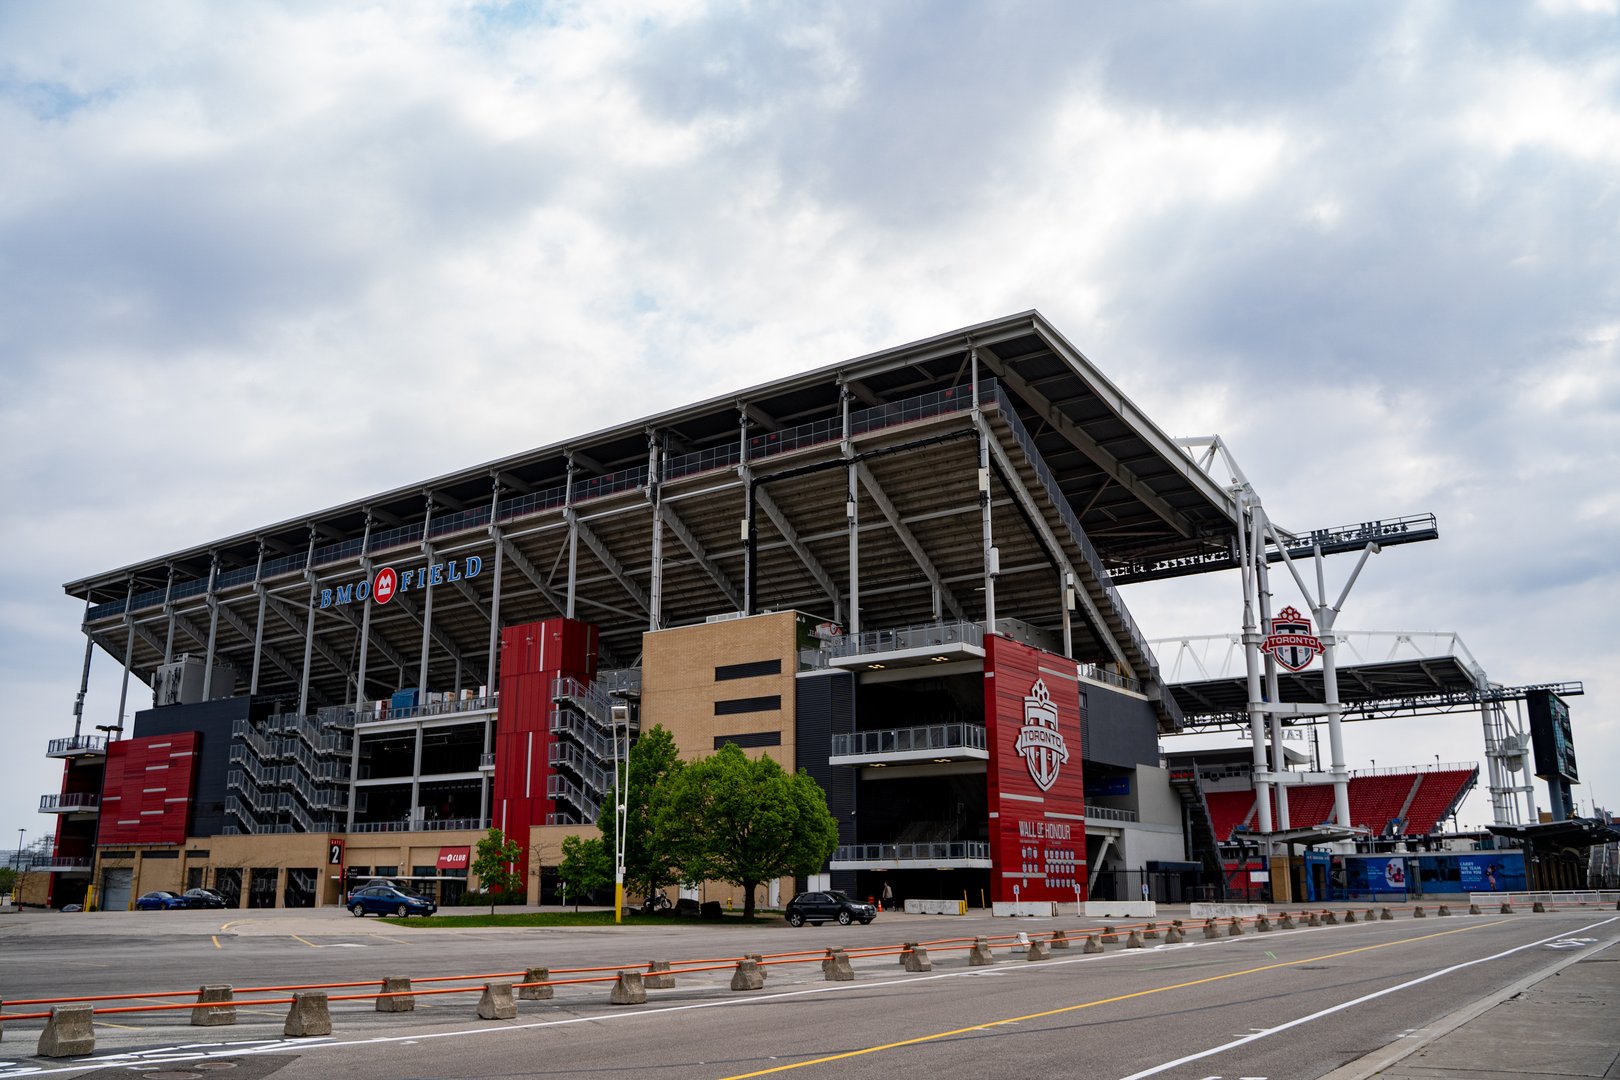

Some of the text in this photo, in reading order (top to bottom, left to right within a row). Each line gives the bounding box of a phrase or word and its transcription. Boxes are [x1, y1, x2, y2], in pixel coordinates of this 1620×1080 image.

[320, 556, 482, 609] BMO FIELD
[1270, 636, 1316, 646] TORONTO
[1023, 730, 1062, 747] TORONTO
[1019, 821, 1071, 840] WALL OF HONOUR
[331, 845, 340, 864] 2
[452, 854, 466, 862] CLUB
